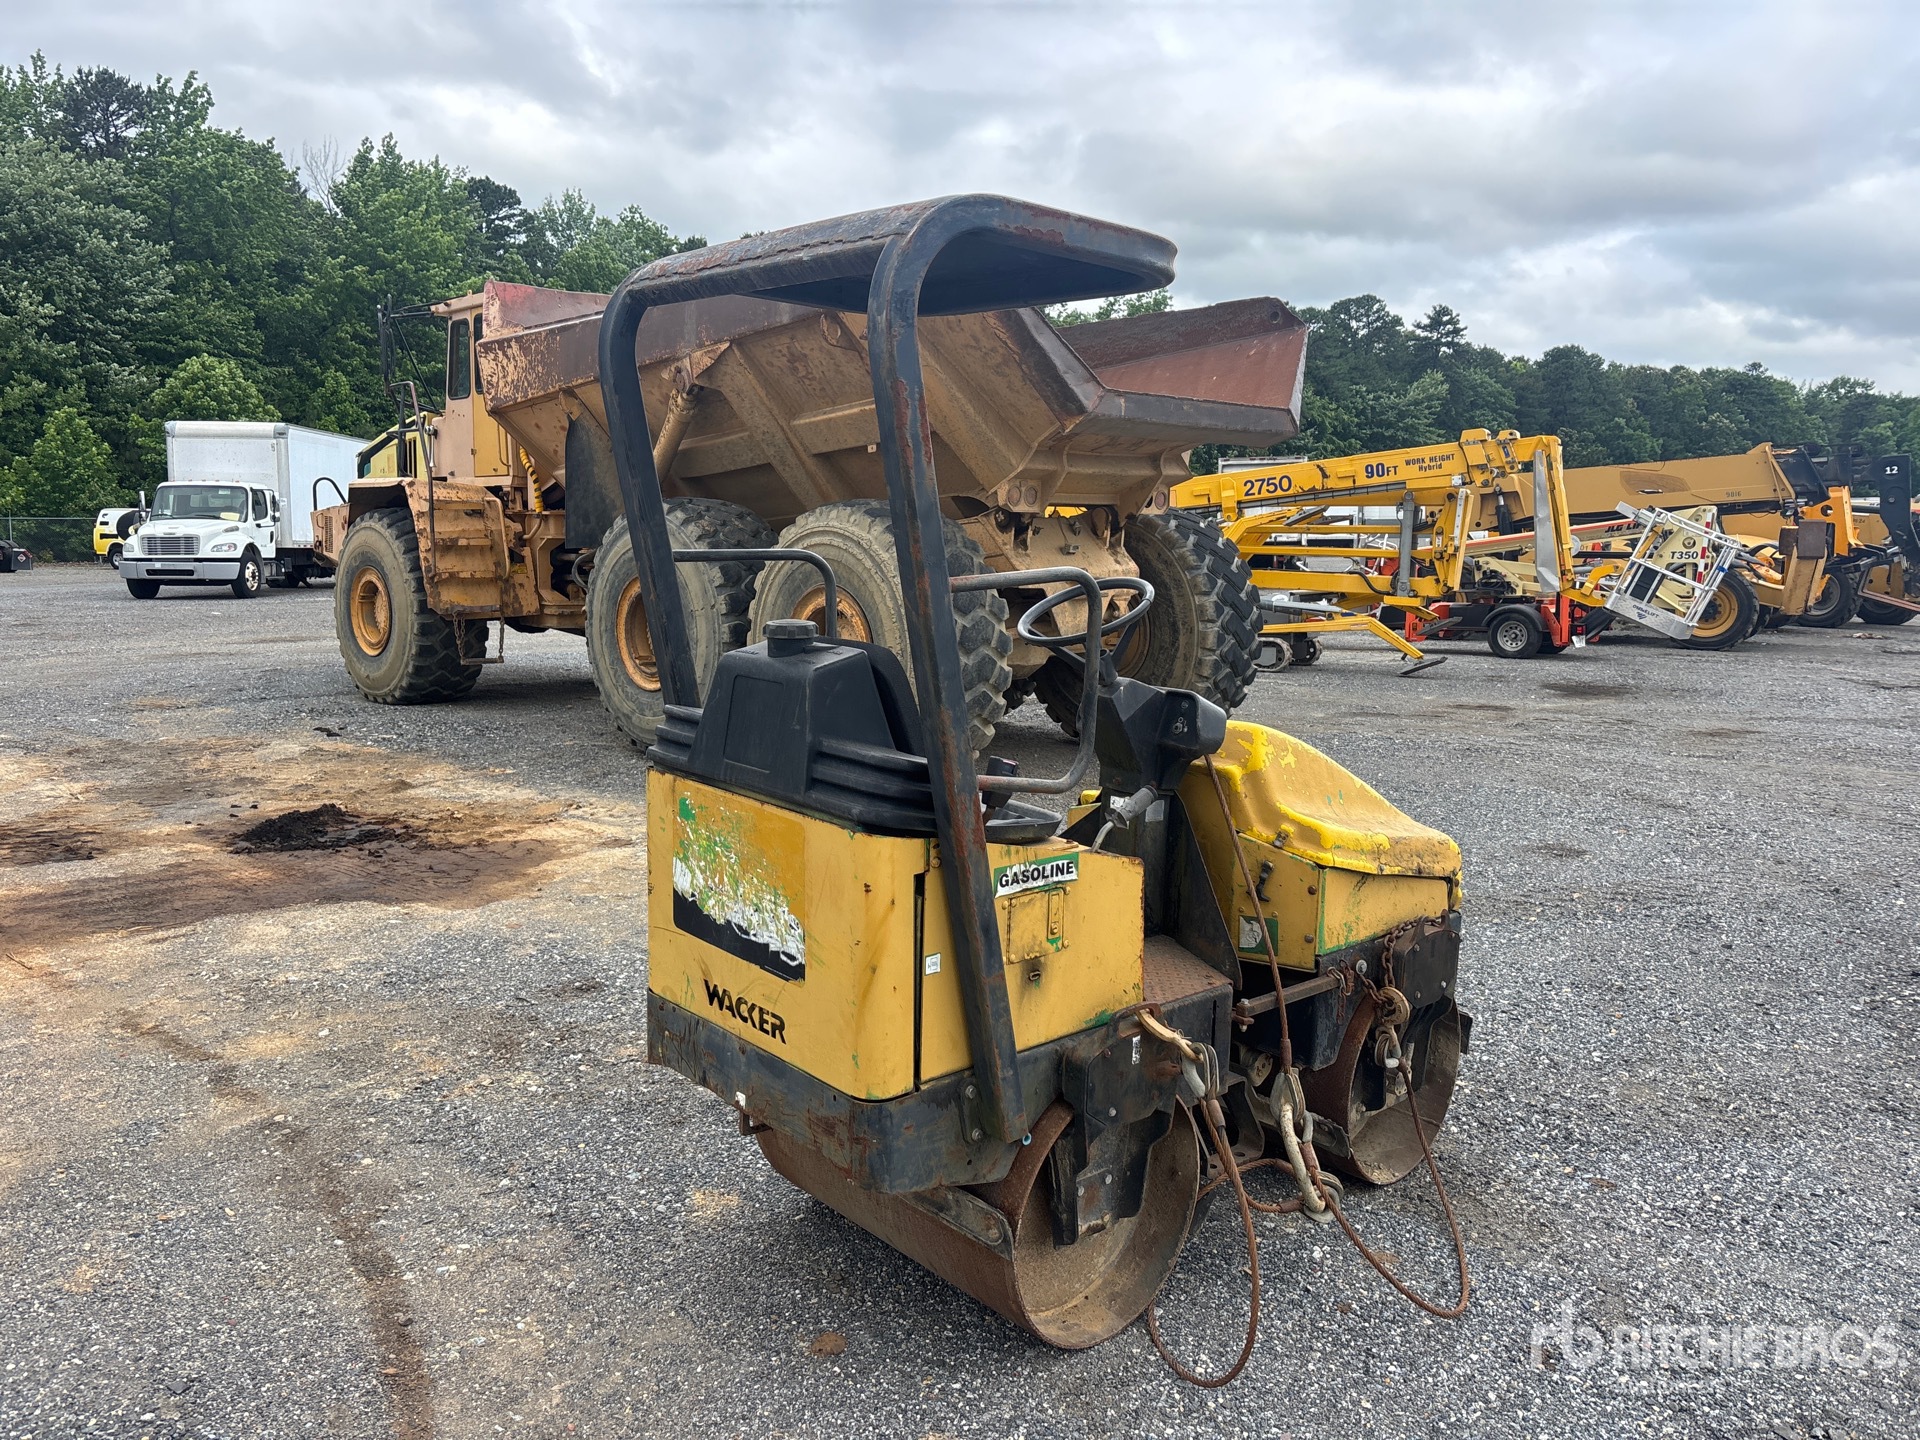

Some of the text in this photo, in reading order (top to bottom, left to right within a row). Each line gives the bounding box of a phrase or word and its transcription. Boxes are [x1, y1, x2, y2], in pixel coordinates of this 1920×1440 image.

[1404, 453, 1455, 467] WORK HEIGHT
[1418, 462, 1443, 473] Hybrid
[1885, 465, 1898, 475] 12
[1243, 474, 1293, 497] 2750
[1604, 524, 1623, 533] JLG
[1670, 550, 1699, 560] T350
[999, 861, 1074, 888] GASOLINE
[703, 978, 787, 1045] WACKER
